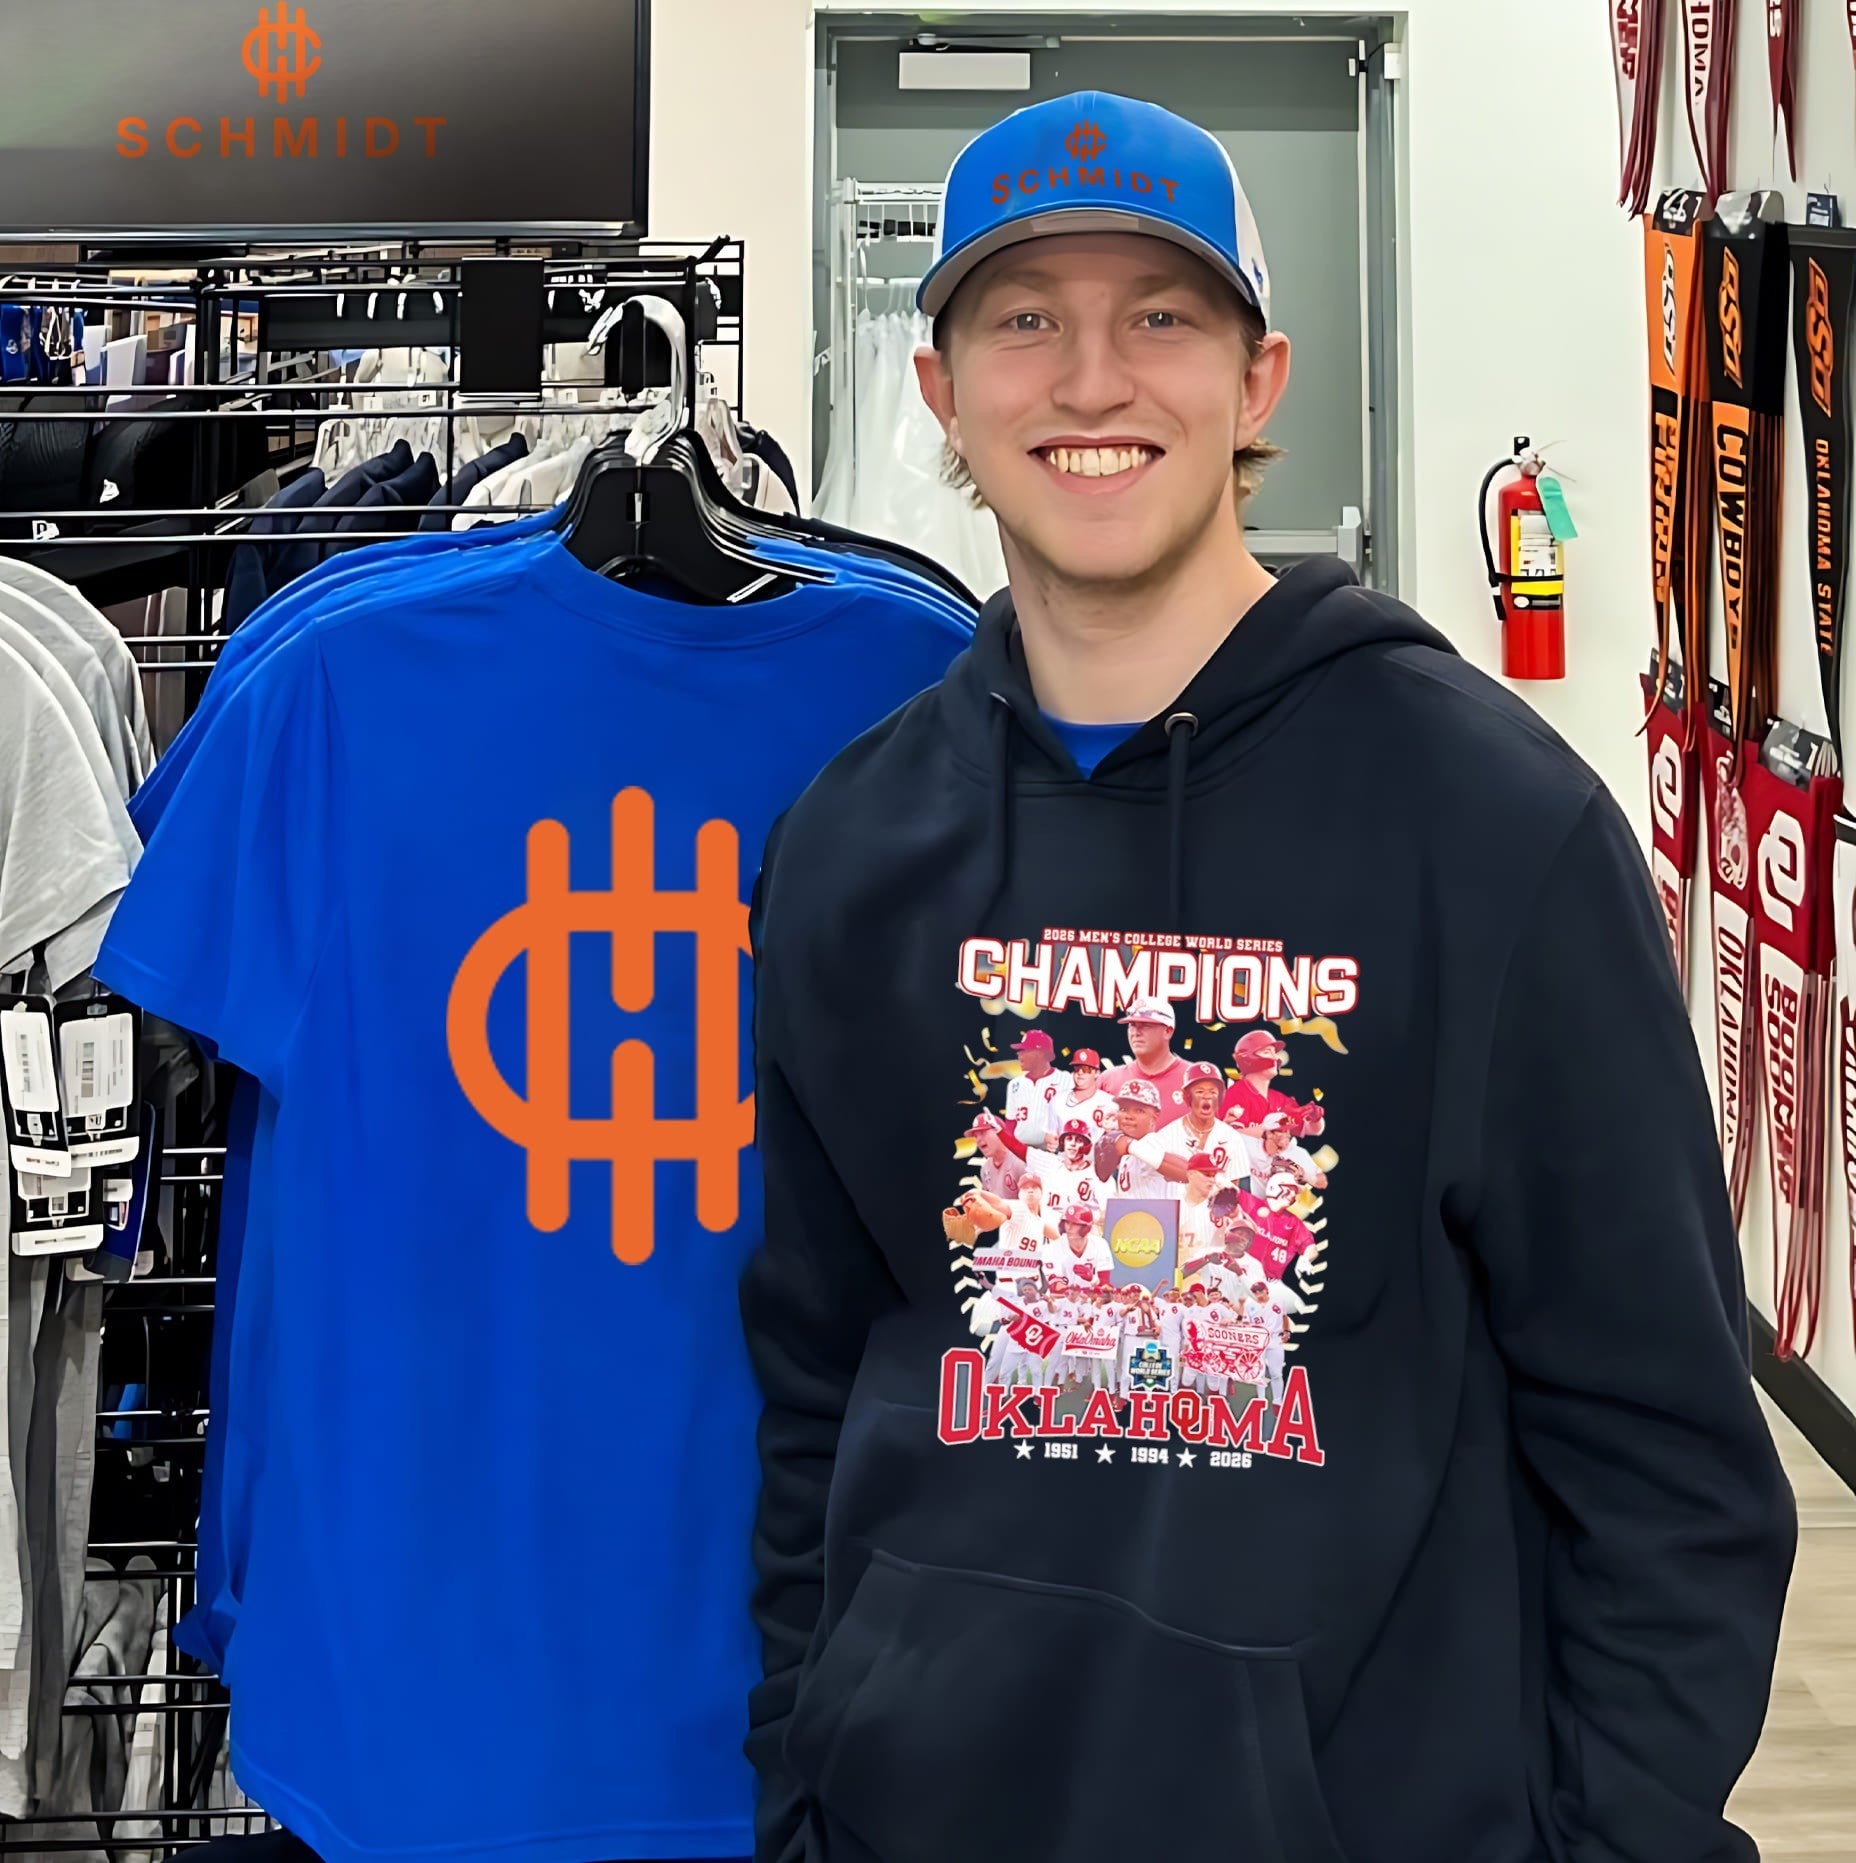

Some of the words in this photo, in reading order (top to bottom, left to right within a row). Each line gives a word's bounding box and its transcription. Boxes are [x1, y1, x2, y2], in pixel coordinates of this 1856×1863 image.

[116, 116, 448, 159] SCHMIDT
[991, 166, 1179, 205] SCHMIDT
[1815, 438, 1832, 570] OKLAHOMA
[1043, 928, 1075, 942] 2026
[1078, 930, 1120, 944] MEN'S
[1124, 932, 1181, 948] COLLEGE
[1185, 935, 1233, 950] WORLD
[1236, 937, 1283, 952] SERIES
[958, 937, 1360, 1024] CHAMPIONS
[1717, 924, 1745, 1144] OKLAHOMA
[1019, 1236, 1037, 1252] 99
[1114, 1238, 1162, 1255] NCAA
[1207, 1327, 1260, 1345] SOONERS
[1044, 1441, 1079, 1460] 1951
[1130, 1445, 1169, 1465] 1994
[1209, 1450, 1253, 1469] 2026
